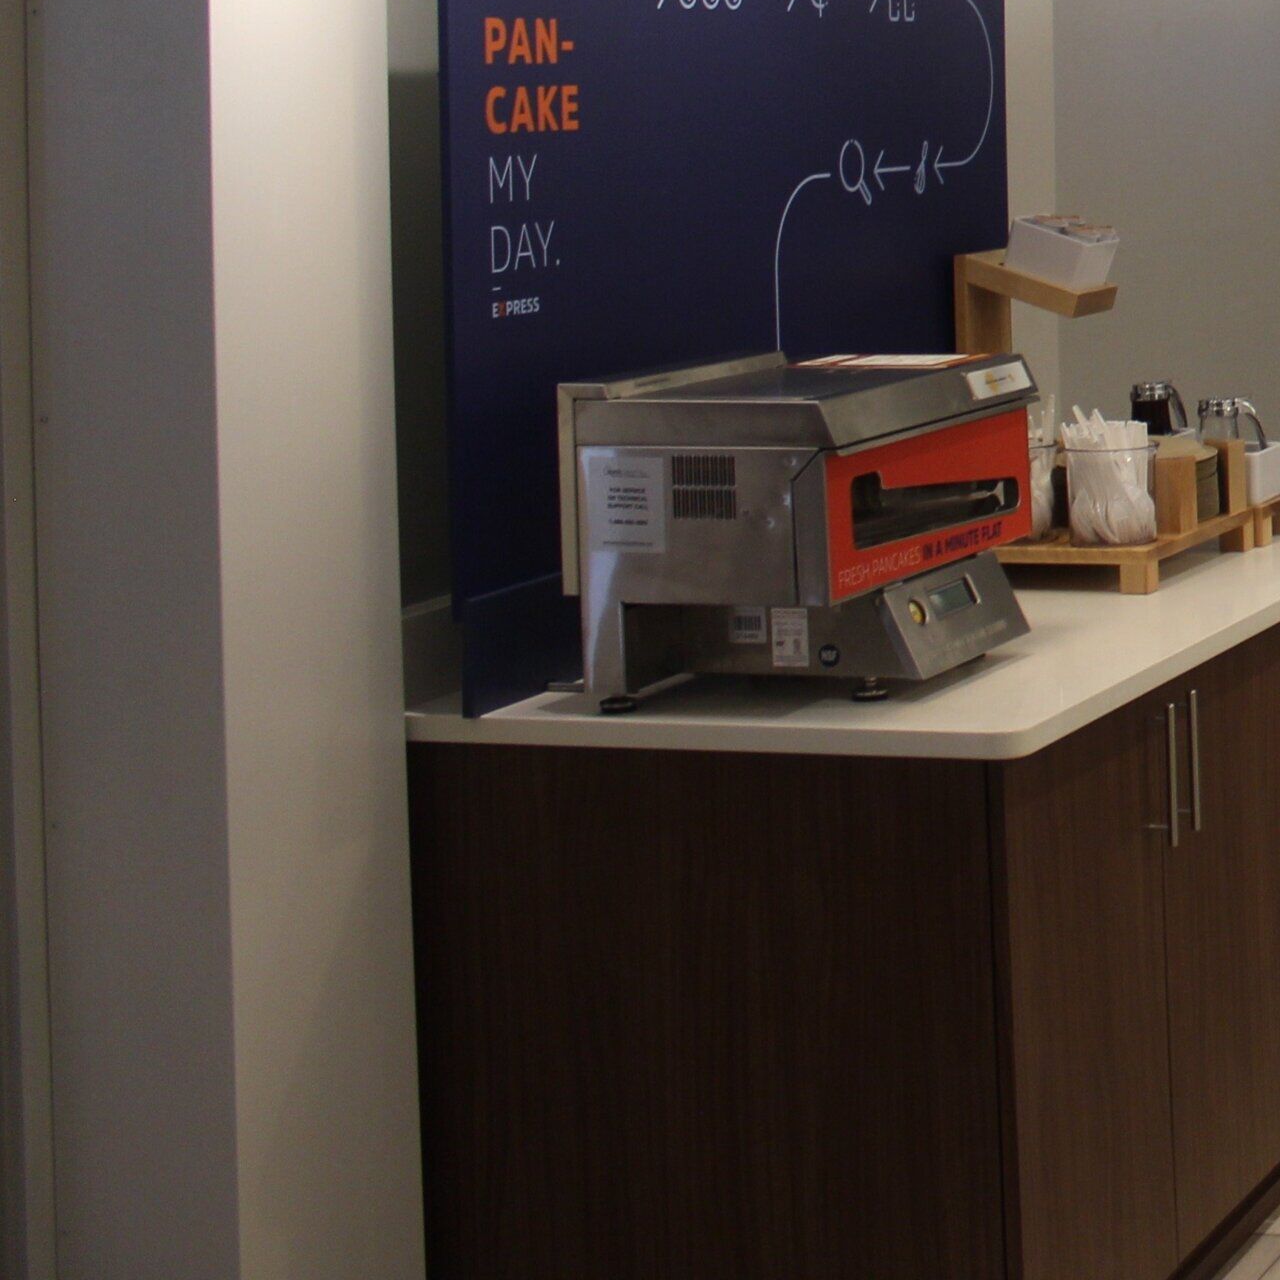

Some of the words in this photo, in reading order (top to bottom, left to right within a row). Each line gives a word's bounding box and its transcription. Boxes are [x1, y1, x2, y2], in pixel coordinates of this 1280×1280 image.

[483, 16, 575, 65] PAN-
[485, 84, 580, 135] CAKE
[489, 153, 538, 204] MY
[490, 220, 561, 274] DAY.
[492, 296, 541, 319] EXPRESS
[838, 565, 871, 589] FRESH
[872, 546, 921, 576] PANCAKES
[922, 544, 933, 561] IN
[935, 541, 944, 557] A
[945, 529, 980, 553] MINUTE
[981, 521, 1003, 542] FLAT
